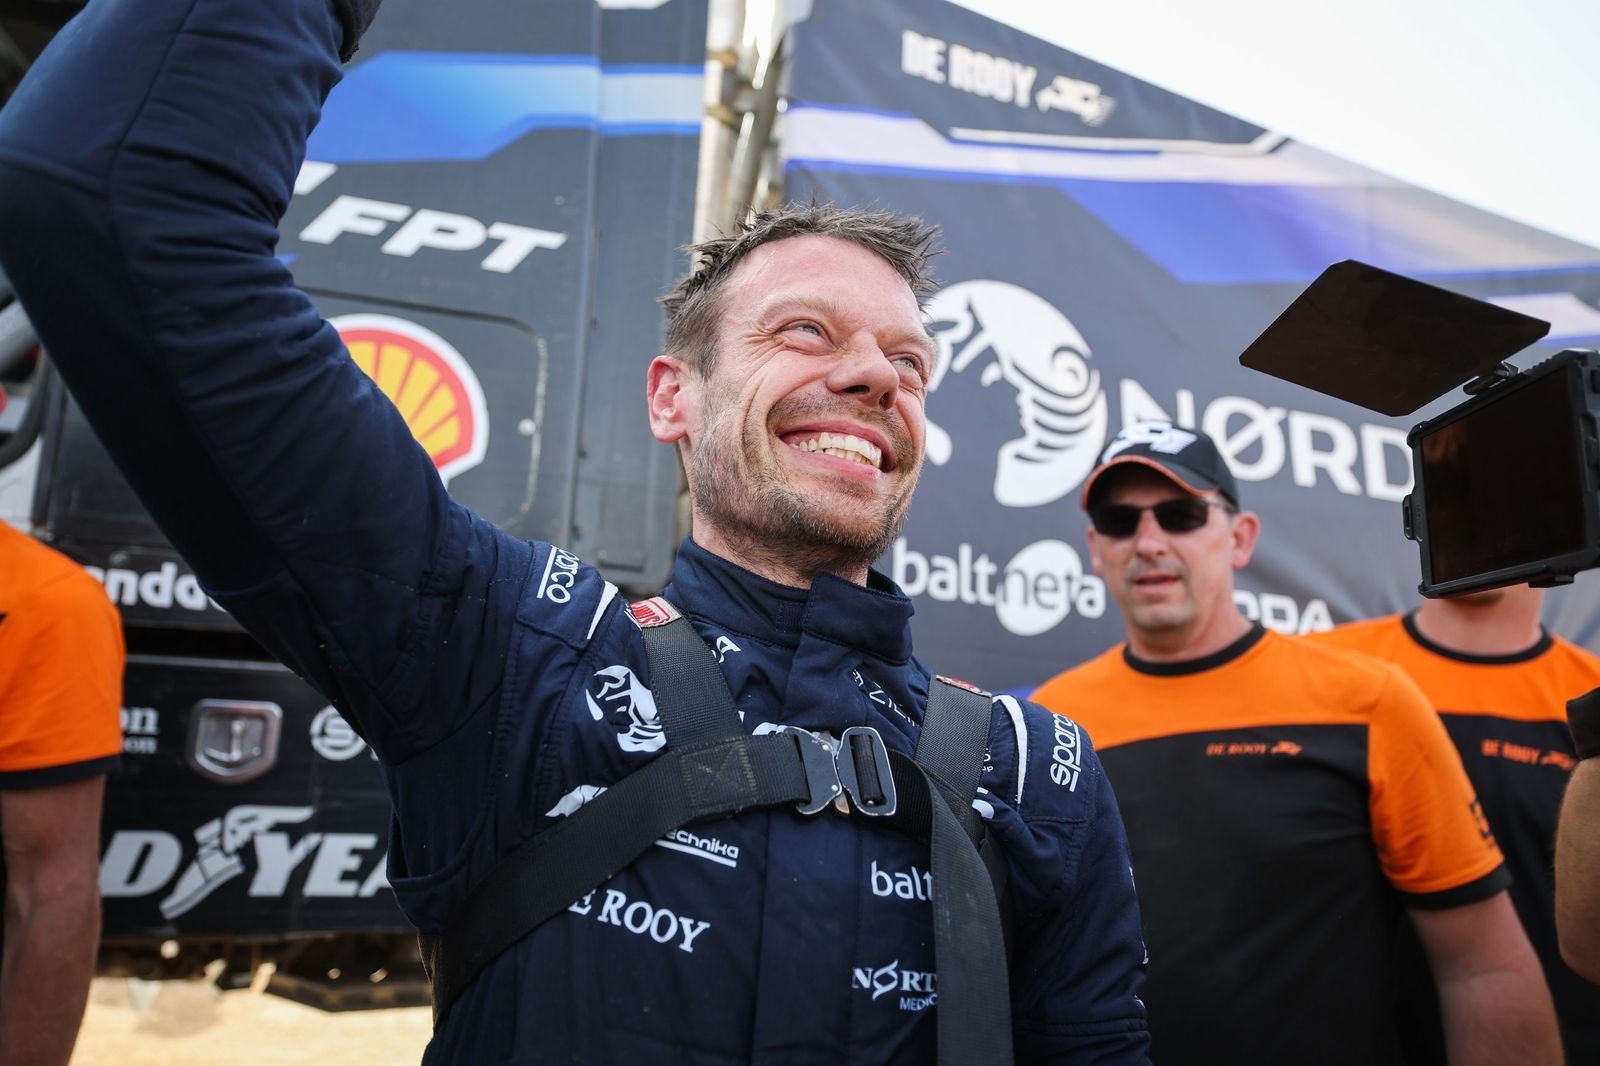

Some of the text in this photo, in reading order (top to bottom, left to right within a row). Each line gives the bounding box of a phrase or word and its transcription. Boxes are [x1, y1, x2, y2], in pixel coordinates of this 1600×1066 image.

[902, 29, 1038, 109] DE ROOY
[298, 194, 568, 274] FPT
[893, 536, 1106, 630] baltneta
[597, 889, 711, 953] ROOY
